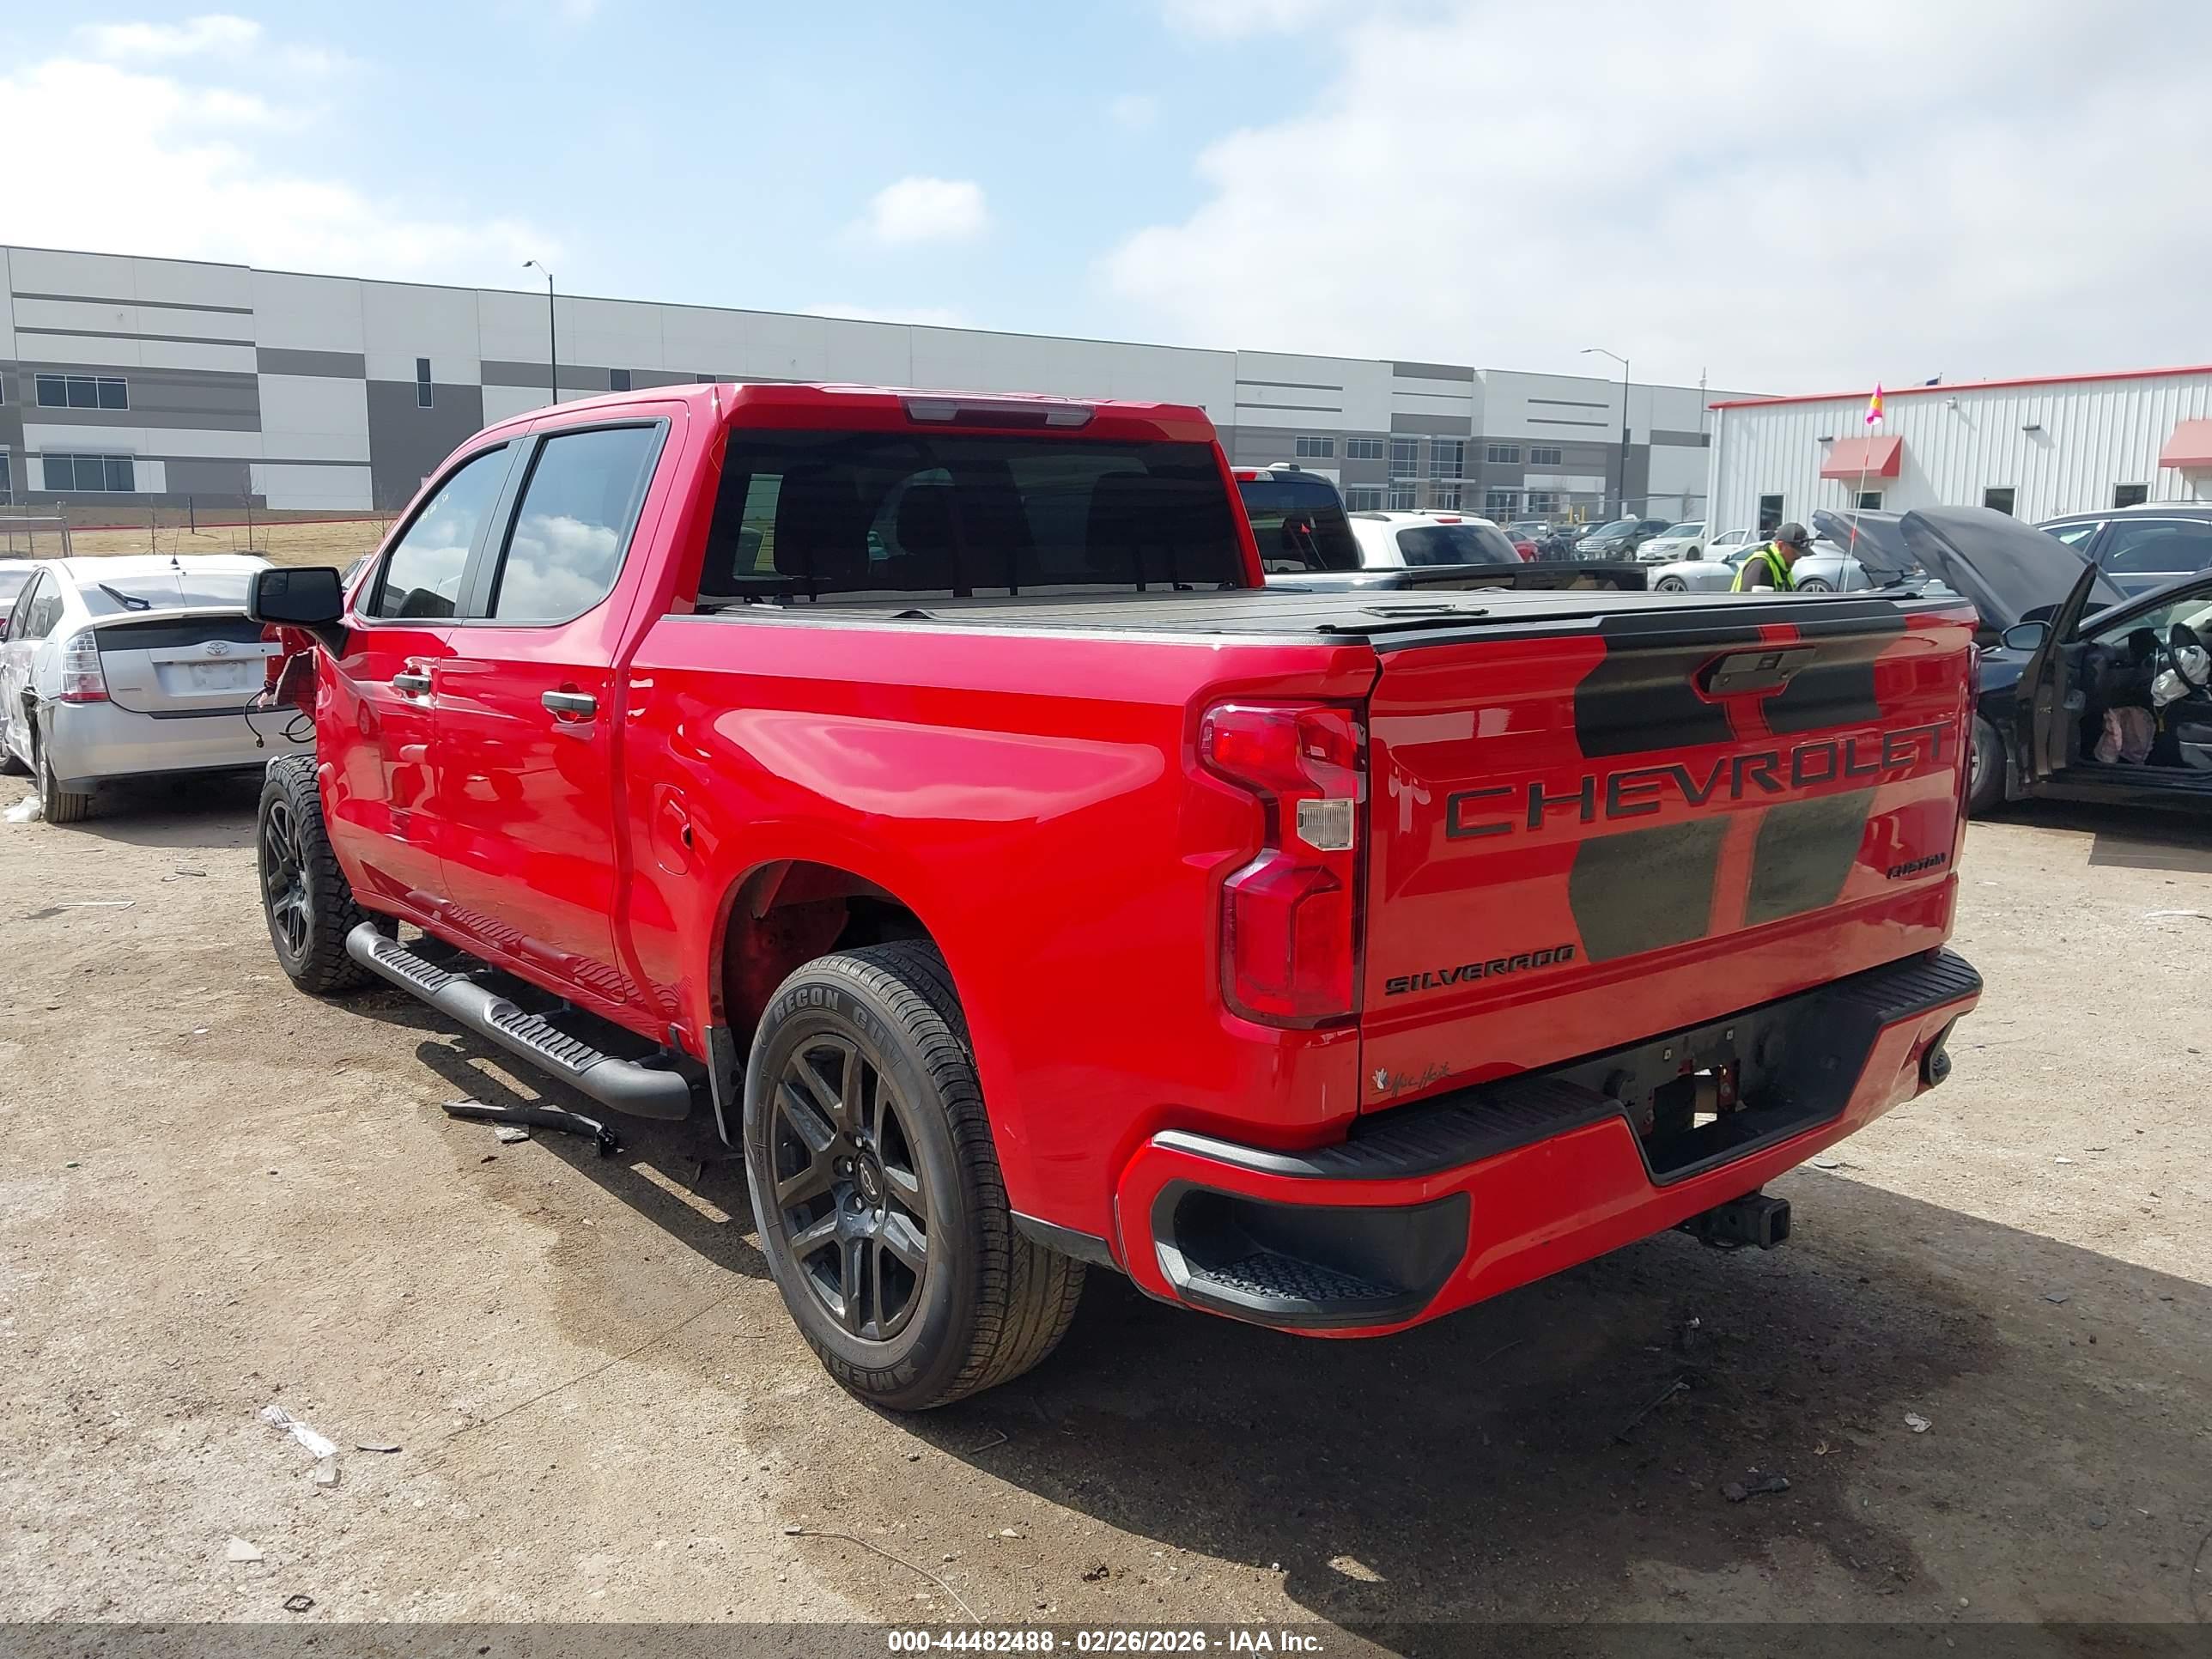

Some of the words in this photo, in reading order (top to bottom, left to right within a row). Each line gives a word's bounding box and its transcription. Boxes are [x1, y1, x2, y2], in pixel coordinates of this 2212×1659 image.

[1446, 720, 1953, 839] CHEVROLET
[1384, 944, 1576, 996] SILVERADO
[774, 987, 839, 1024] RECON
